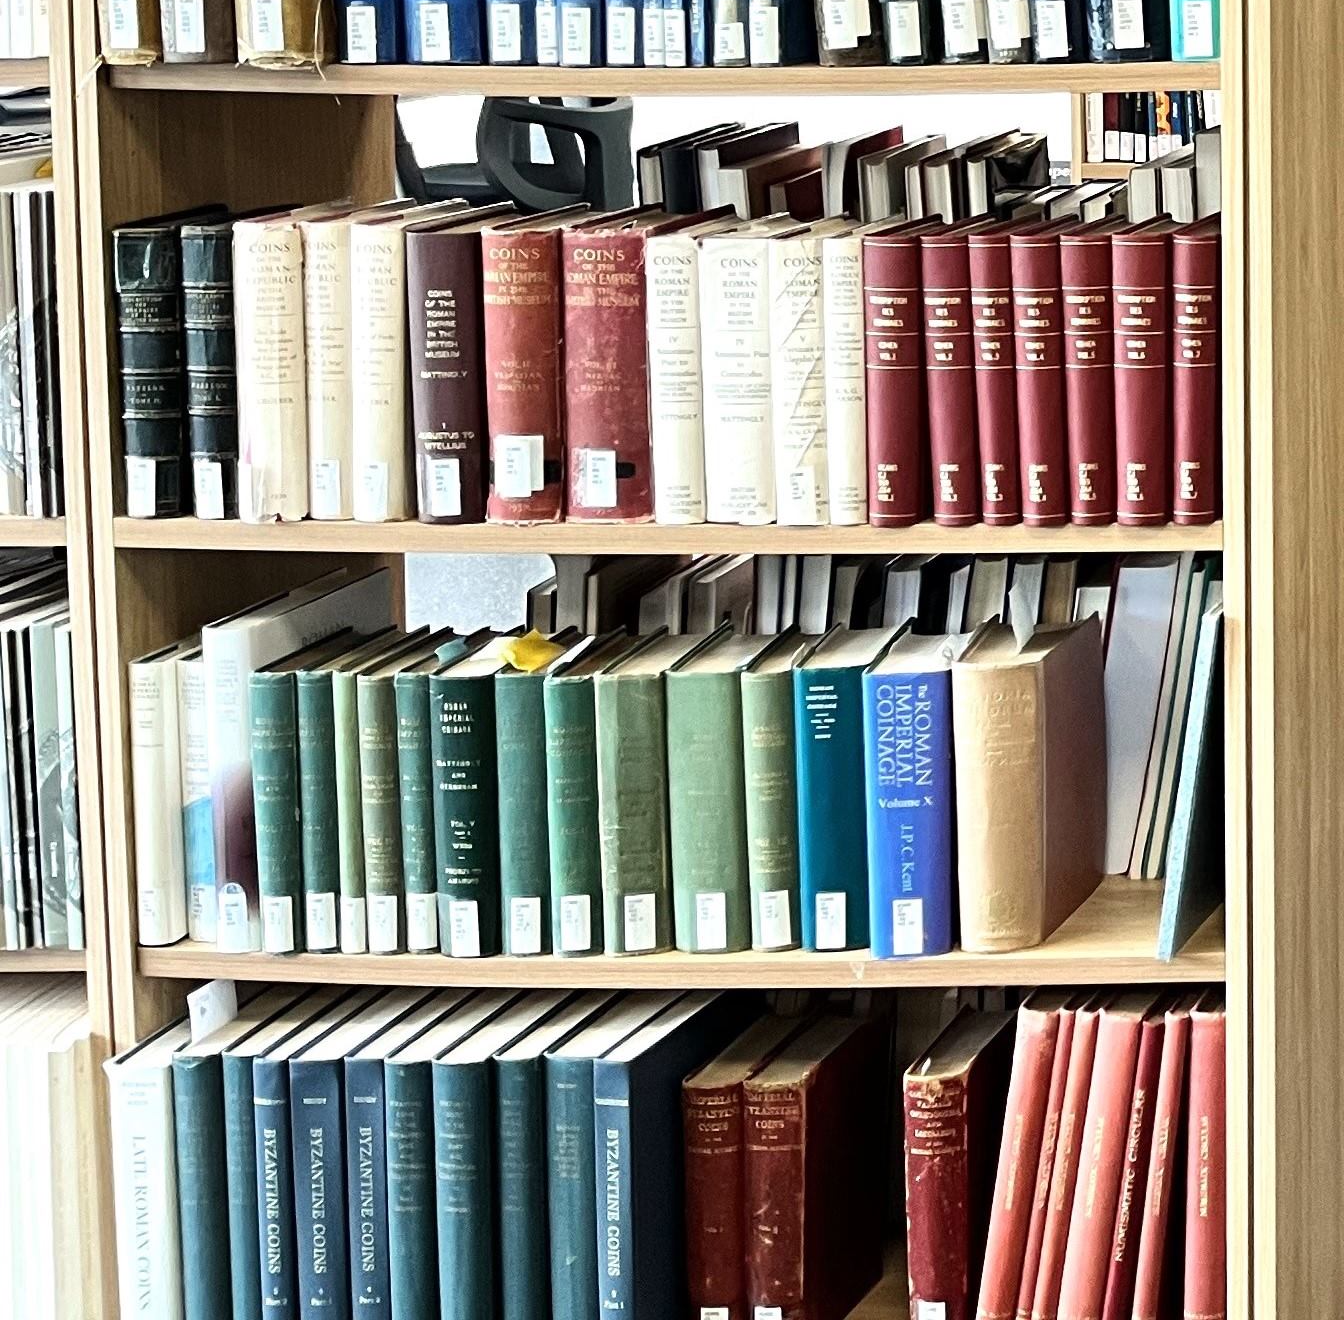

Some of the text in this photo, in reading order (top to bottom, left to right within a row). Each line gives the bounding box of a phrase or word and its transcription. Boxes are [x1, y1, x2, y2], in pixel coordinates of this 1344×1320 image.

[248, 243, 291, 254] COINS
[489, 248, 541, 259] COINS
[574, 249, 625, 261] COINS
[653, 256, 692, 266] COINS
[720, 258, 758, 268] COINS
[784, 256, 822, 268] COINS
[654, 277, 690, 286] ROMAN
[656, 288, 689, 297] EMPIRE
[918, 683, 929, 698] The
[876, 684, 896, 787] COINAGE
[895, 684, 914, 788] IMPERIAL
[914, 700, 933, 787] ROMAN
[878, 795, 935, 809] Volume X
[901, 861, 914, 892] Kent
[755, 1119, 785, 1129] COINS
[1113, 1089, 1147, 1262] NUMISMATIC CIRCULAR
[263, 1128, 281, 1274] BYZANTINE COINS
[310, 1128, 327, 1274] BYZANTINE COINS
[359, 1126, 375, 1272] BYZANTINE COINS
[607, 1129, 621, 1277] BYZANTINE COINS
[134, 1185, 150, 1251] ROMAN
[137, 1257, 151, 1311] COINS
